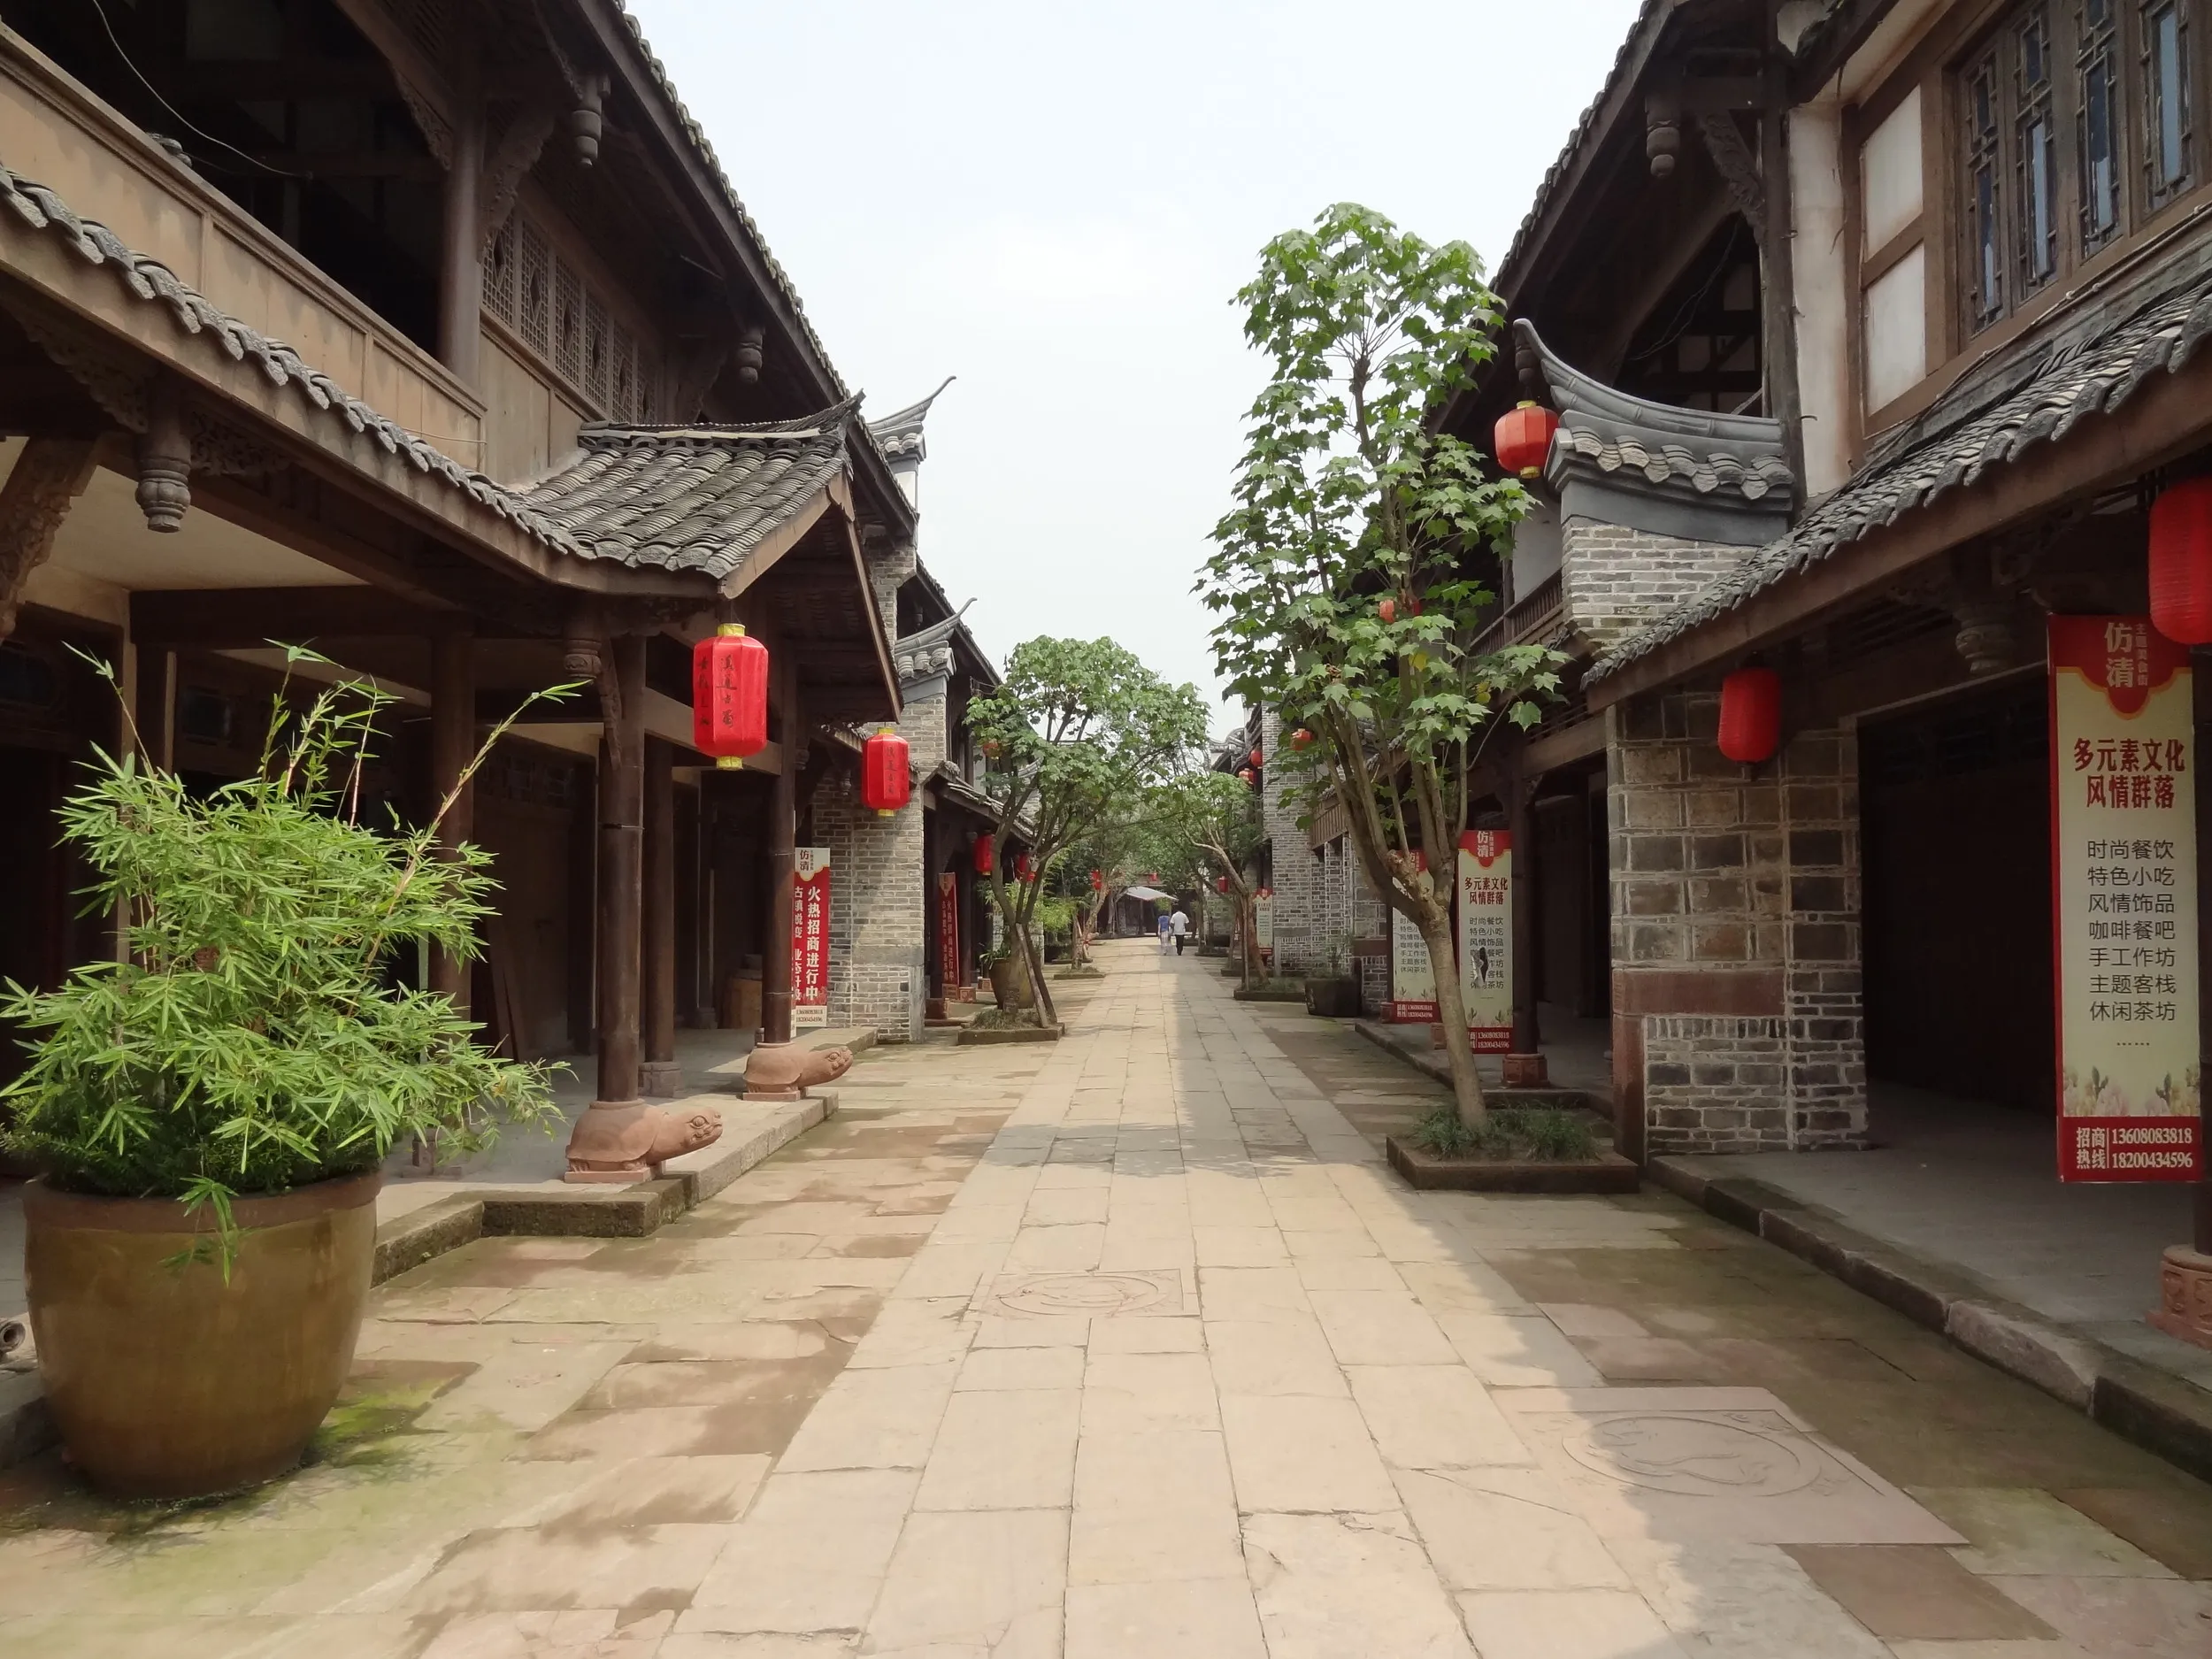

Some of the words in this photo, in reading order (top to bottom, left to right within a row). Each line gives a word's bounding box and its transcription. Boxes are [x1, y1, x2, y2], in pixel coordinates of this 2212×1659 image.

[2104, 622, 2134, 688] 仿清
[2074, 738, 2185, 772] 多元素文化
[2086, 775, 2175, 810] 风情群落
[1477, 830, 1489, 858] 仿清
[2087, 840, 2174, 860] 时尚餐饮
[800, 849, 810, 872] 仿清
[1464, 877, 1508, 891] 多元素文化
[2087, 867, 2176, 887] 特色小吃
[1469, 891, 1504, 905] 风情群落
[2087, 894, 2175, 913] 风情饰品
[1469, 917, 1503, 926] 时尚餐饮
[1470, 927, 1503, 936] 特色小吃
[2088, 920, 2176, 941] 咖啡餐吧
[805, 887, 820, 1001] 火热招商进行中
[1470, 938, 1503, 947] 风情饰品
[2088, 948, 2176, 967] 手工作坊
[2090, 974, 2177, 994] 主题客栈
[2089, 1002, 2177, 1021] 休闲茶坊
[2076, 1126, 2105, 1148] 招商
[2112, 1127, 2193, 1144] 13608083818
[2076, 1148, 2106, 1169] 热线
[2112, 1152, 2193, 1168] 18200434596
